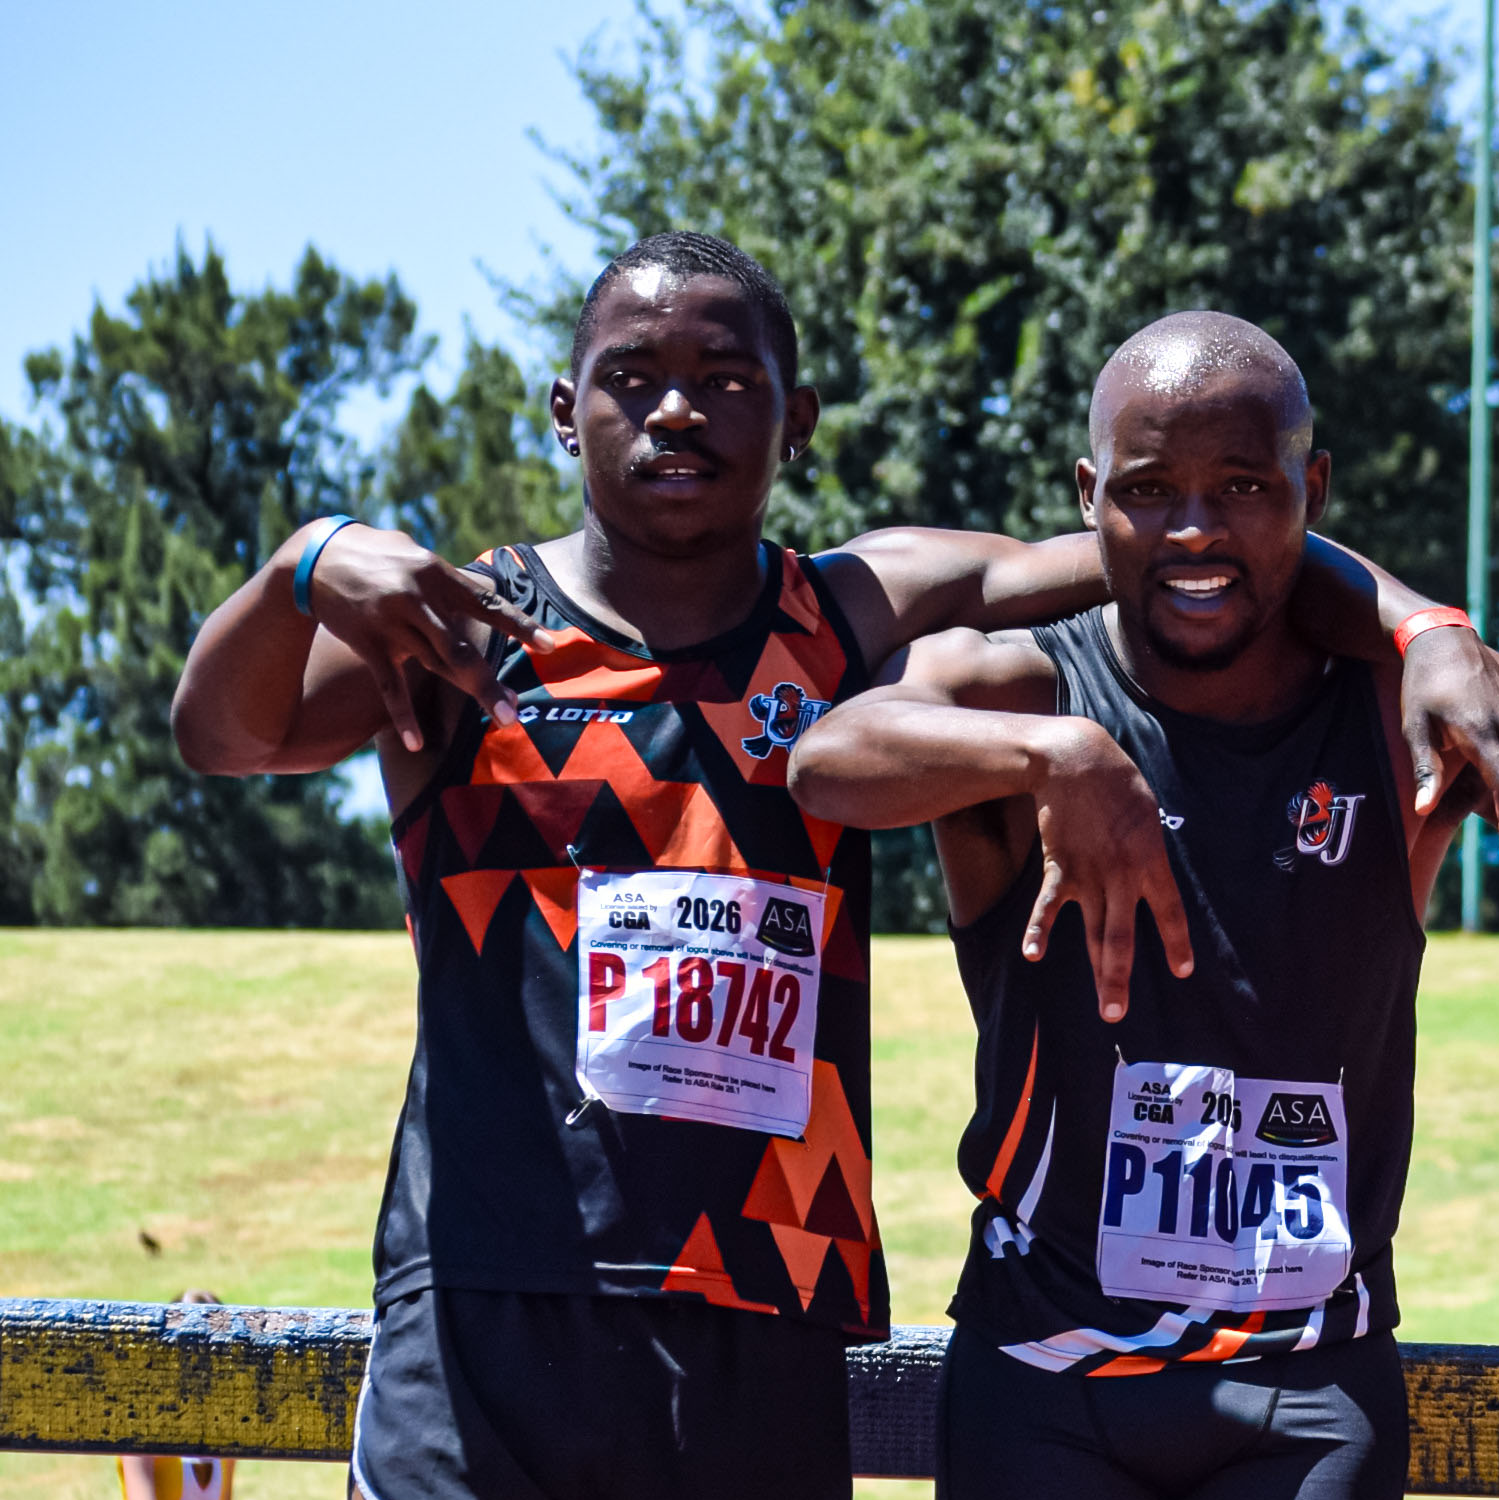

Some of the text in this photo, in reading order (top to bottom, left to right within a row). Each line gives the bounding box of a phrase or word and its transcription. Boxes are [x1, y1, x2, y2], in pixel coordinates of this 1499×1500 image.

[545, 706, 635, 724] LOTTO
[613, 893, 646, 903] ASA
[649, 904, 658, 912] by
[677, 896, 742, 934] 2026
[608, 911, 651, 930] CGA
[765, 904, 809, 937] ASA
[590, 939, 628, 951] Covering
[675, 944, 685, 952] of
[652, 1064, 662, 1072] of
[684, 1078, 692, 1086] to
[693, 1079, 710, 1089] ASA
[1140, 1081, 1171, 1096] ASA
[1133, 1102, 1174, 1125] CGA
[1267, 1100, 1327, 1125] ASA
[1113, 1130, 1150, 1144] Covering
[1268, 1151, 1277, 1160] to
[1141, 1257, 1166, 1268] Image
[1167, 1260, 1176, 1268] of
[1177, 1261, 1198, 1271] Race
[1199, 1264, 1231, 1276] Sponsor
[1199, 1273, 1208, 1282] to
[1208, 1274, 1226, 1284] ASA
